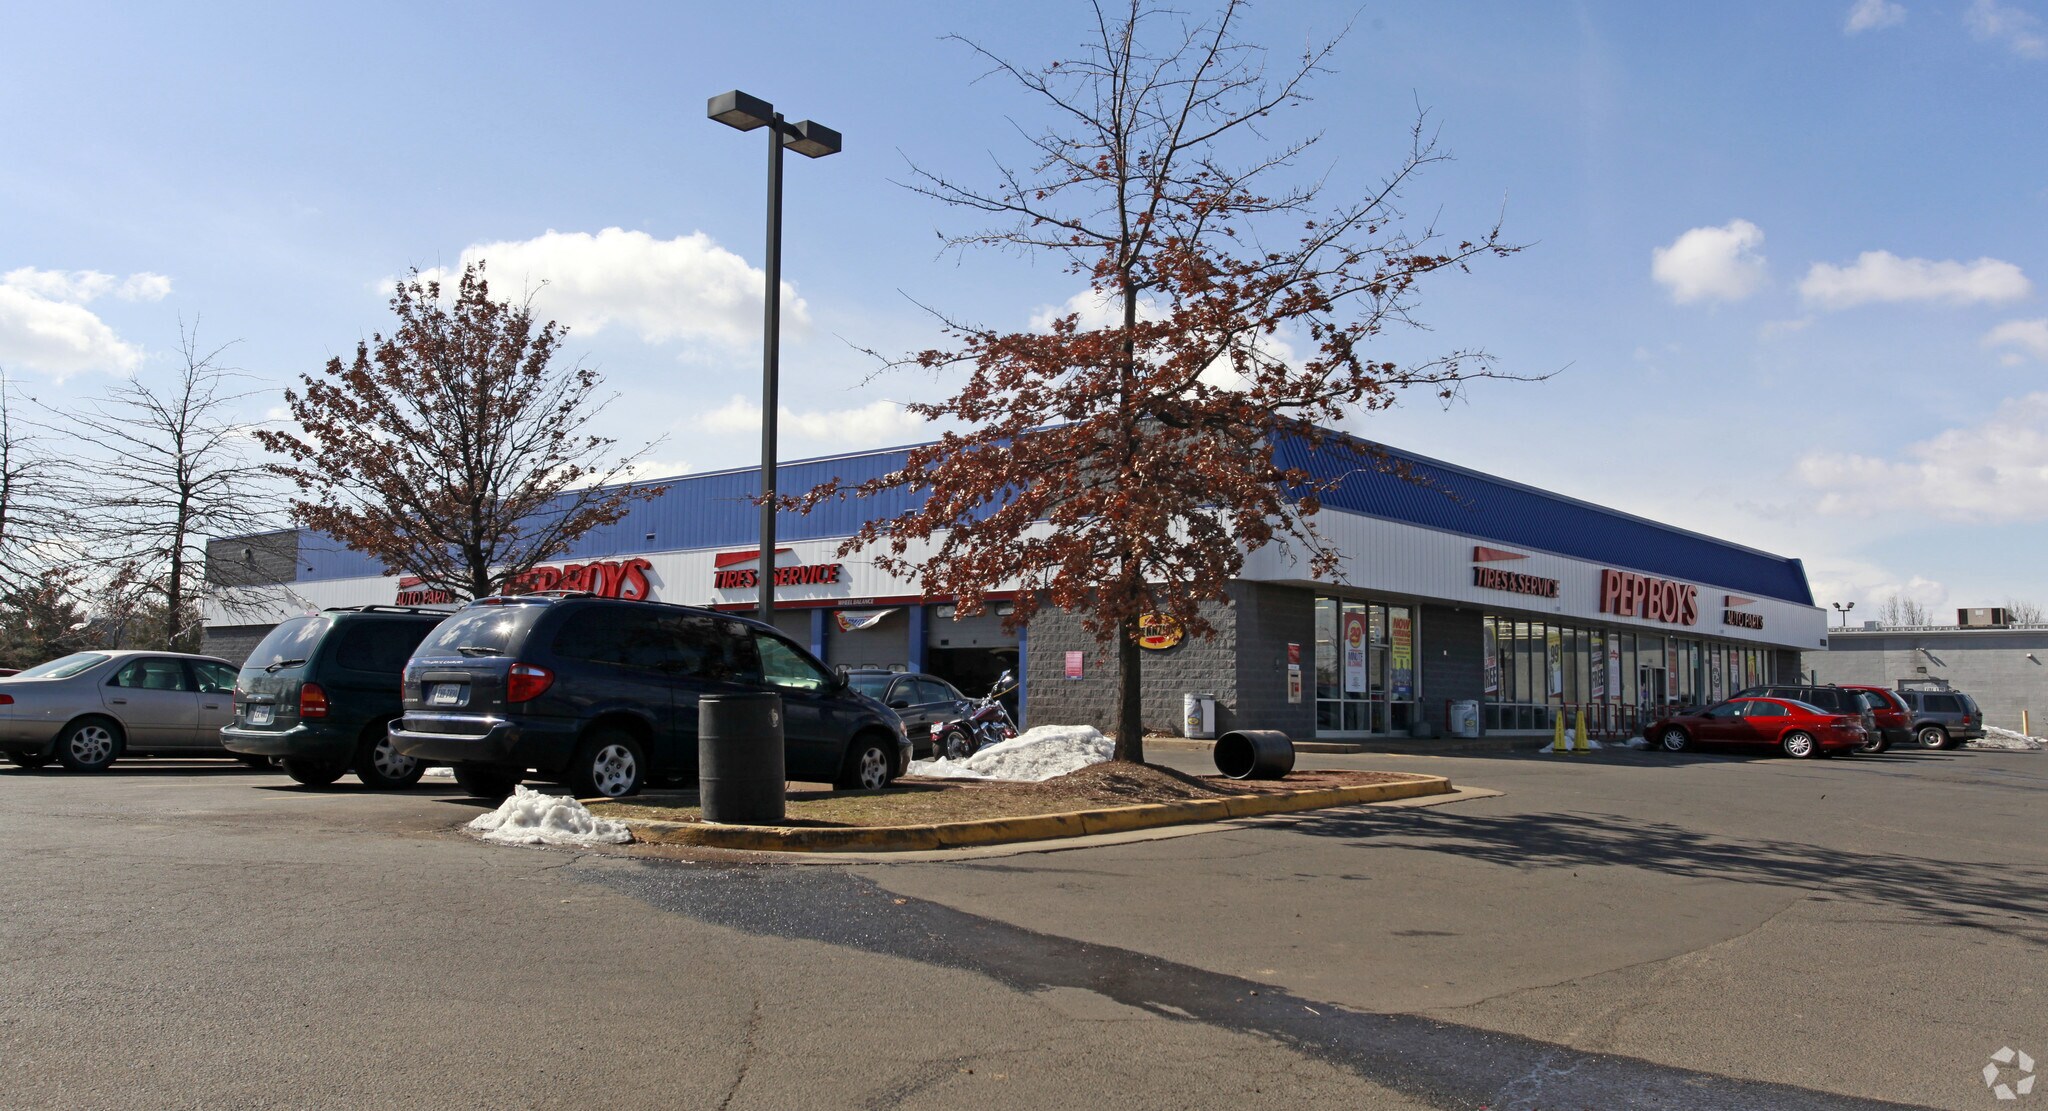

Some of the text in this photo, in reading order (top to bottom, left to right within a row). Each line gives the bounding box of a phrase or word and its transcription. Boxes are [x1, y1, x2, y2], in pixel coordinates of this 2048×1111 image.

[560, 557, 652, 601] BOYS
[714, 563, 841, 588] TIRES SERVICE
[1473, 566, 1560, 598] TIRES & SERVICE
[396, 591, 420, 606] AUTO
[1601, 569, 1698, 626] PEP BOYS
[1393, 617, 1411, 629] NOW
[1725, 610, 1763, 629] AUTO PARTS
